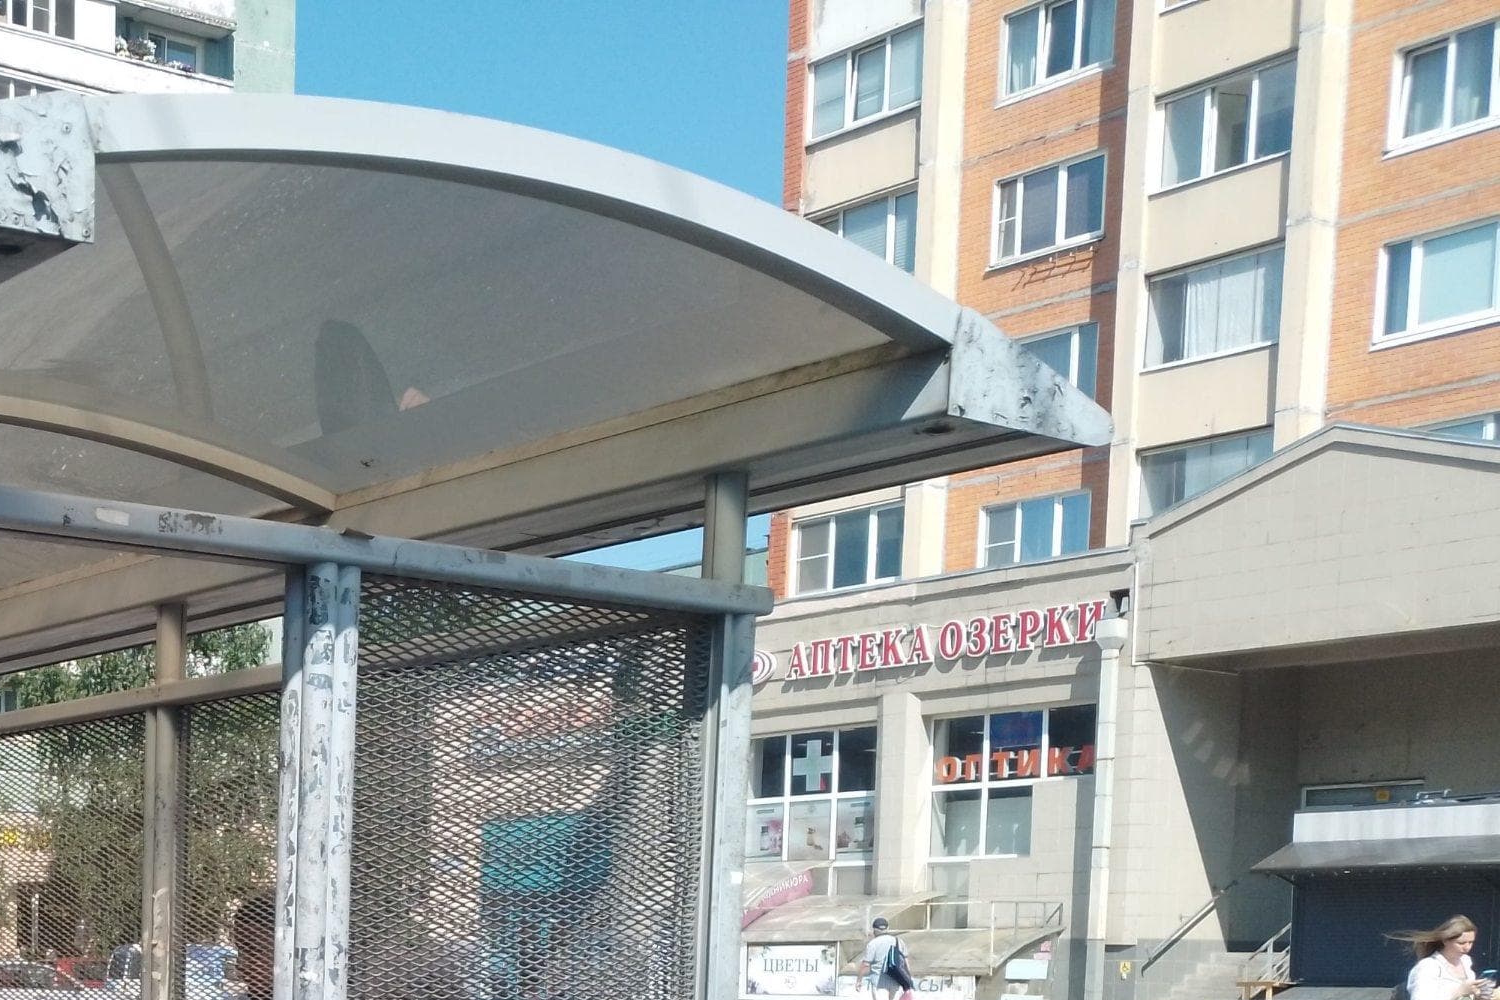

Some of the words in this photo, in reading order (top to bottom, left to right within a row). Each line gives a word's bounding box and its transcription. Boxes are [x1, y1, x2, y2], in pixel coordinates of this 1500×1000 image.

[785, 628, 931, 681] АПТЕКА
[937, 600, 1105, 661] ОЗЕРКИ
[763, 957, 819, 973] ЦВЕТЫ
